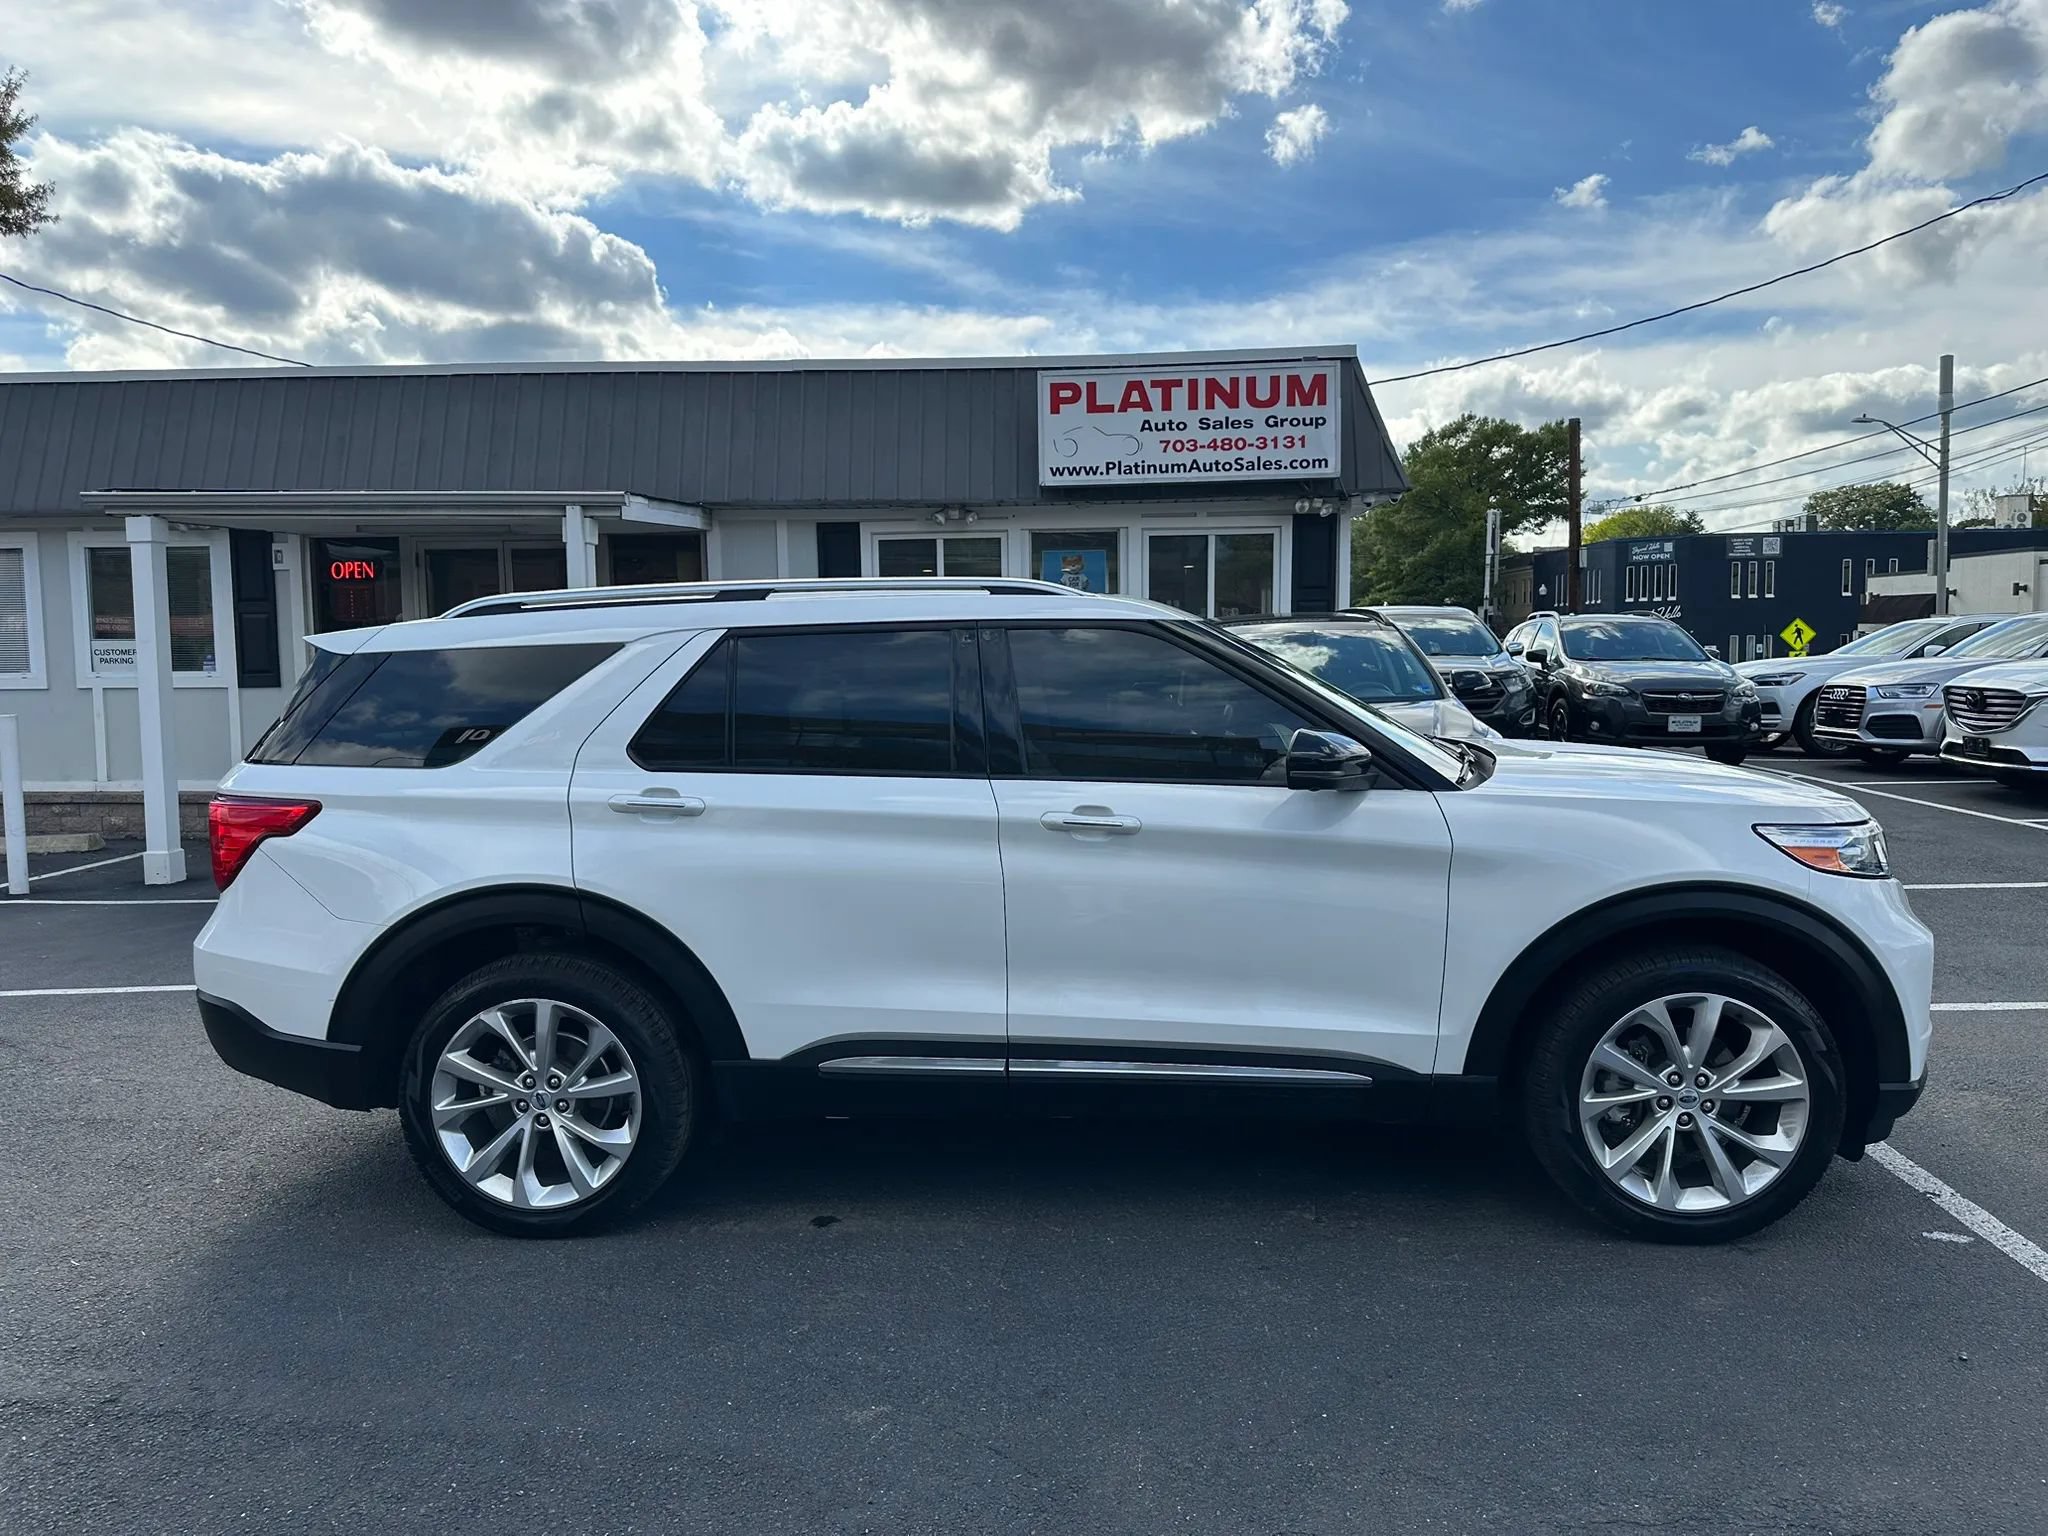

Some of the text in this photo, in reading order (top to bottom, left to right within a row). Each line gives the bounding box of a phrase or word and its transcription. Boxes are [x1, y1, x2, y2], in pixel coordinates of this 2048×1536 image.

[1050, 373, 1328, 415] PLATINUM
[1140, 415, 1327, 433] Auto Sales Group
[1159, 434, 1307, 454] 703-480-3131
[1049, 456, 1329, 477] www.PlatinumAutoSales.com
[331, 561, 374, 579] OPEN
[99, 657, 134, 665] PARKING
